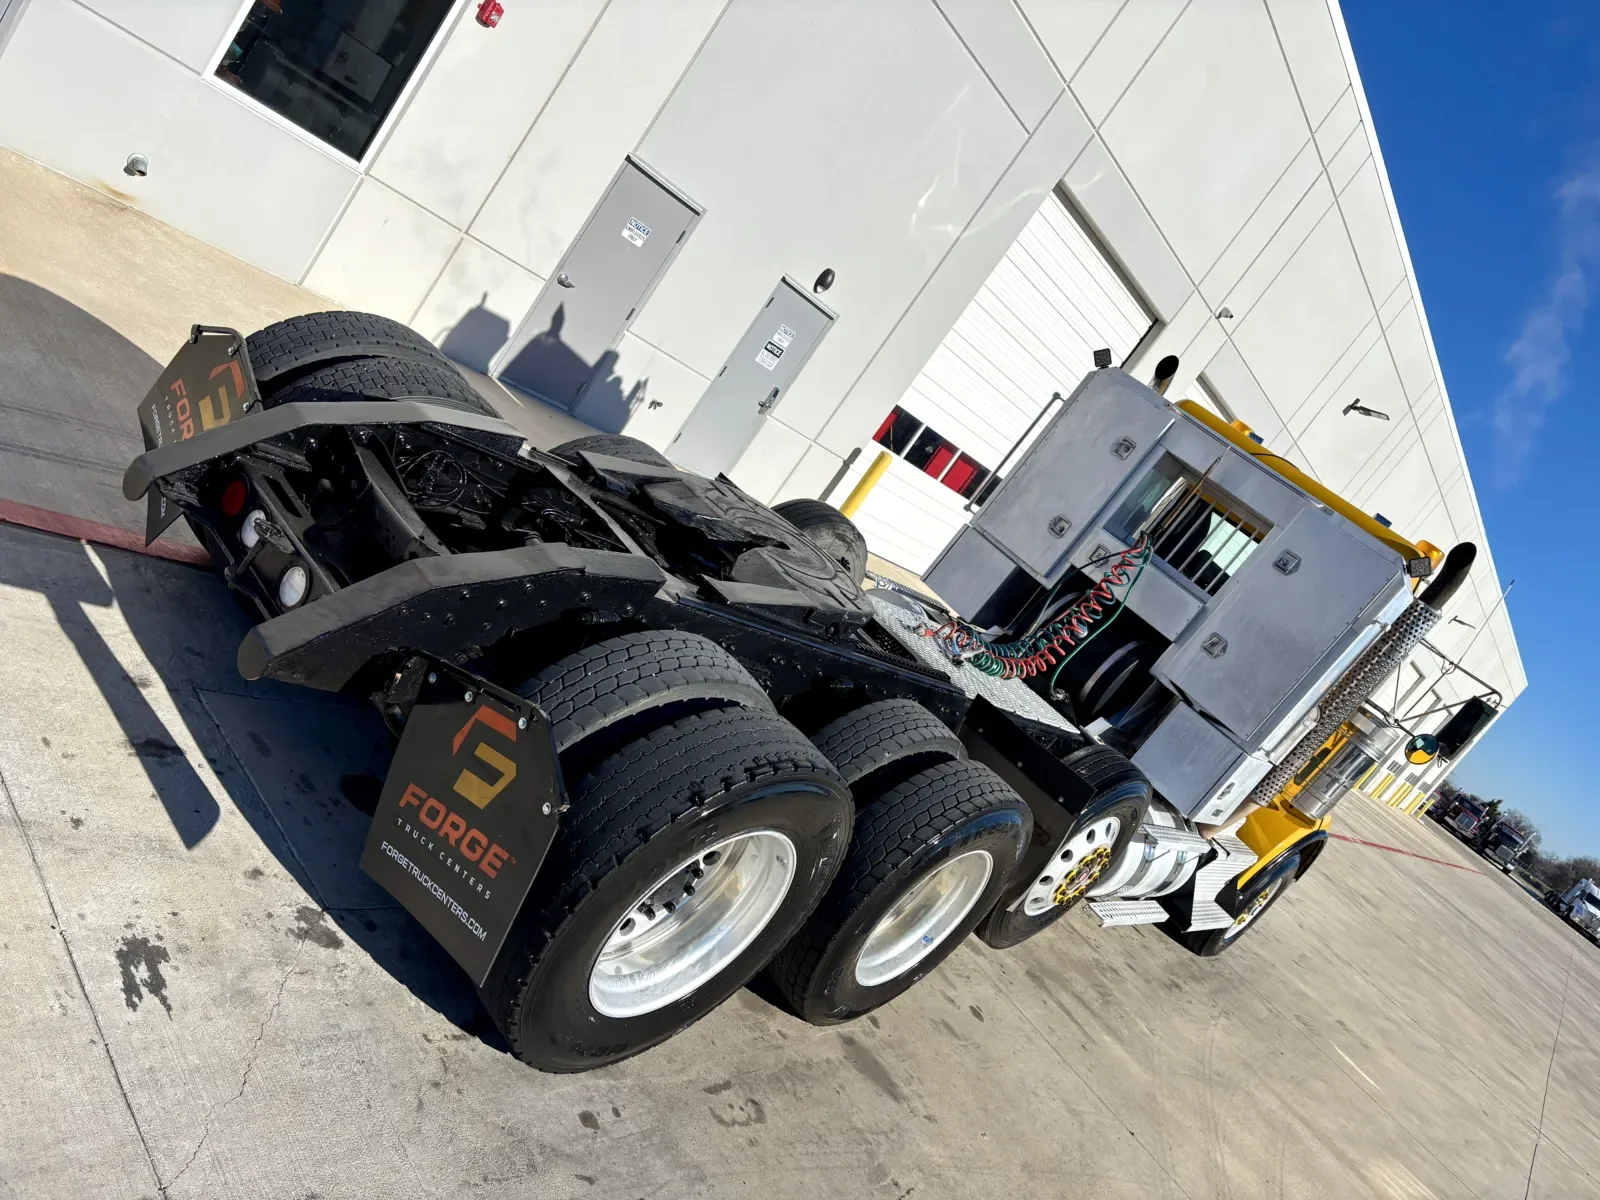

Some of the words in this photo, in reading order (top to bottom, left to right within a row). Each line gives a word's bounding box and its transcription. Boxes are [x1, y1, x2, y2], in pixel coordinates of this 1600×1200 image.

[628, 217, 650, 236] NOTICE
[765, 342, 782, 356] NOTICE
[152, 404, 164, 448] FORGETRU
[170, 378, 194, 441] FOR
[397, 817, 434, 852] TRUCK
[439, 851, 491, 900] CENTERS
[398, 782, 509, 879] FORGE
[380, 840, 488, 942] FORGETRUCKCENTERS.COM
